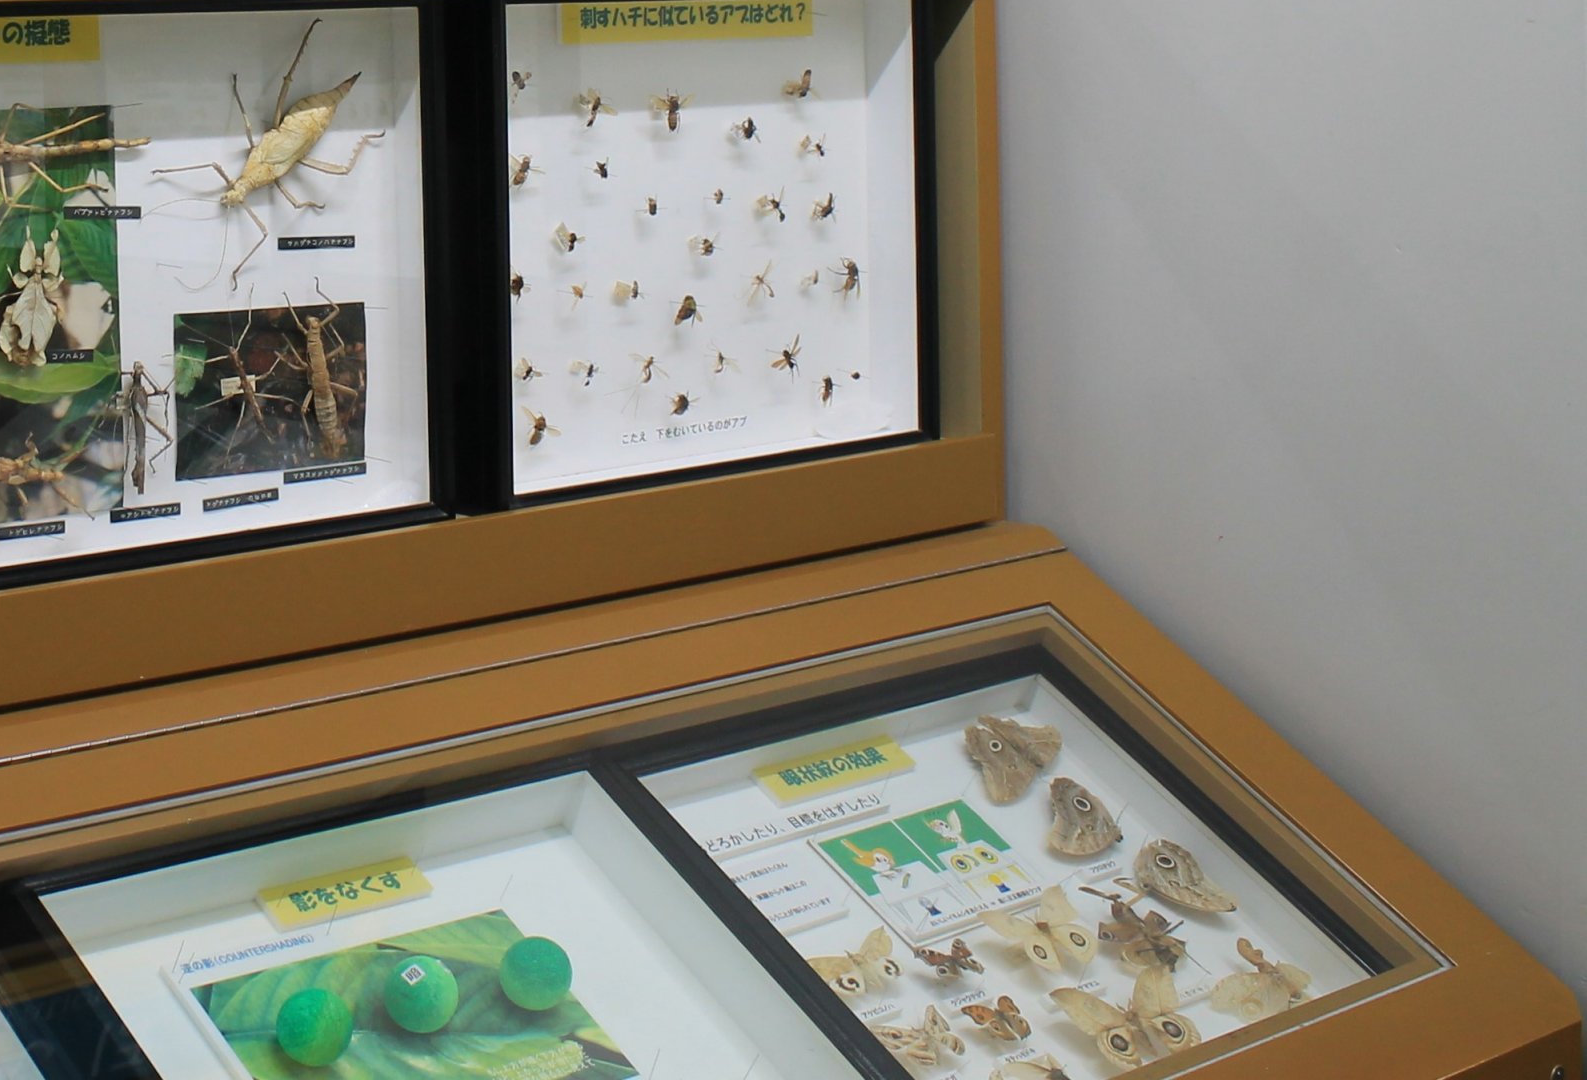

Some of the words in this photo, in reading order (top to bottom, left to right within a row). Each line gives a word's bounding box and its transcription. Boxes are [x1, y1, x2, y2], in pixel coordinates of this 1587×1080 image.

[289, 871, 401, 912] 影をなくす
